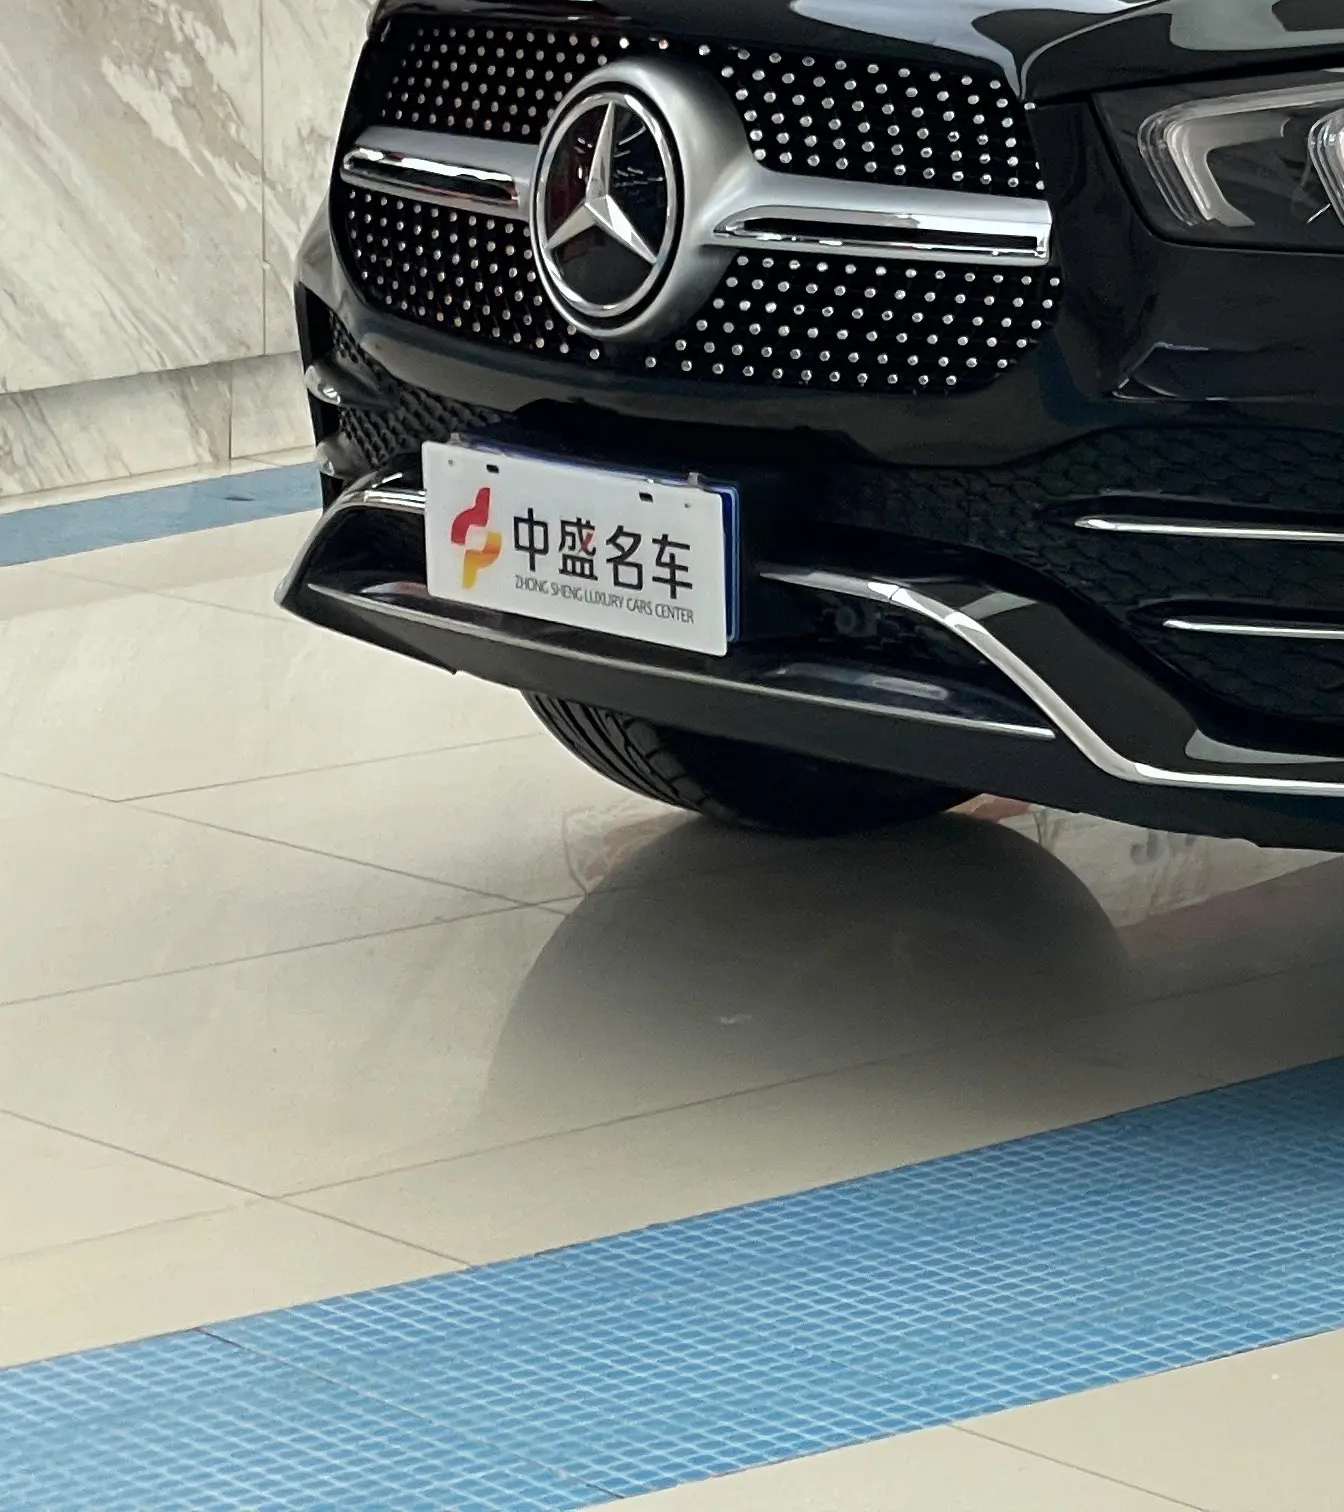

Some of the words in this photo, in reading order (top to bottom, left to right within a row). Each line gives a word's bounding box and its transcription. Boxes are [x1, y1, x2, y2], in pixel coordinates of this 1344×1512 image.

[513, 507, 693, 599] 中盛名车
[514, 574, 548, 594] ZHONG
[551, 582, 583, 602] SHENG
[584, 589, 624, 609] LUXURY
[626, 597, 653, 616] CARS
[654, 603, 695, 624] CENTER
